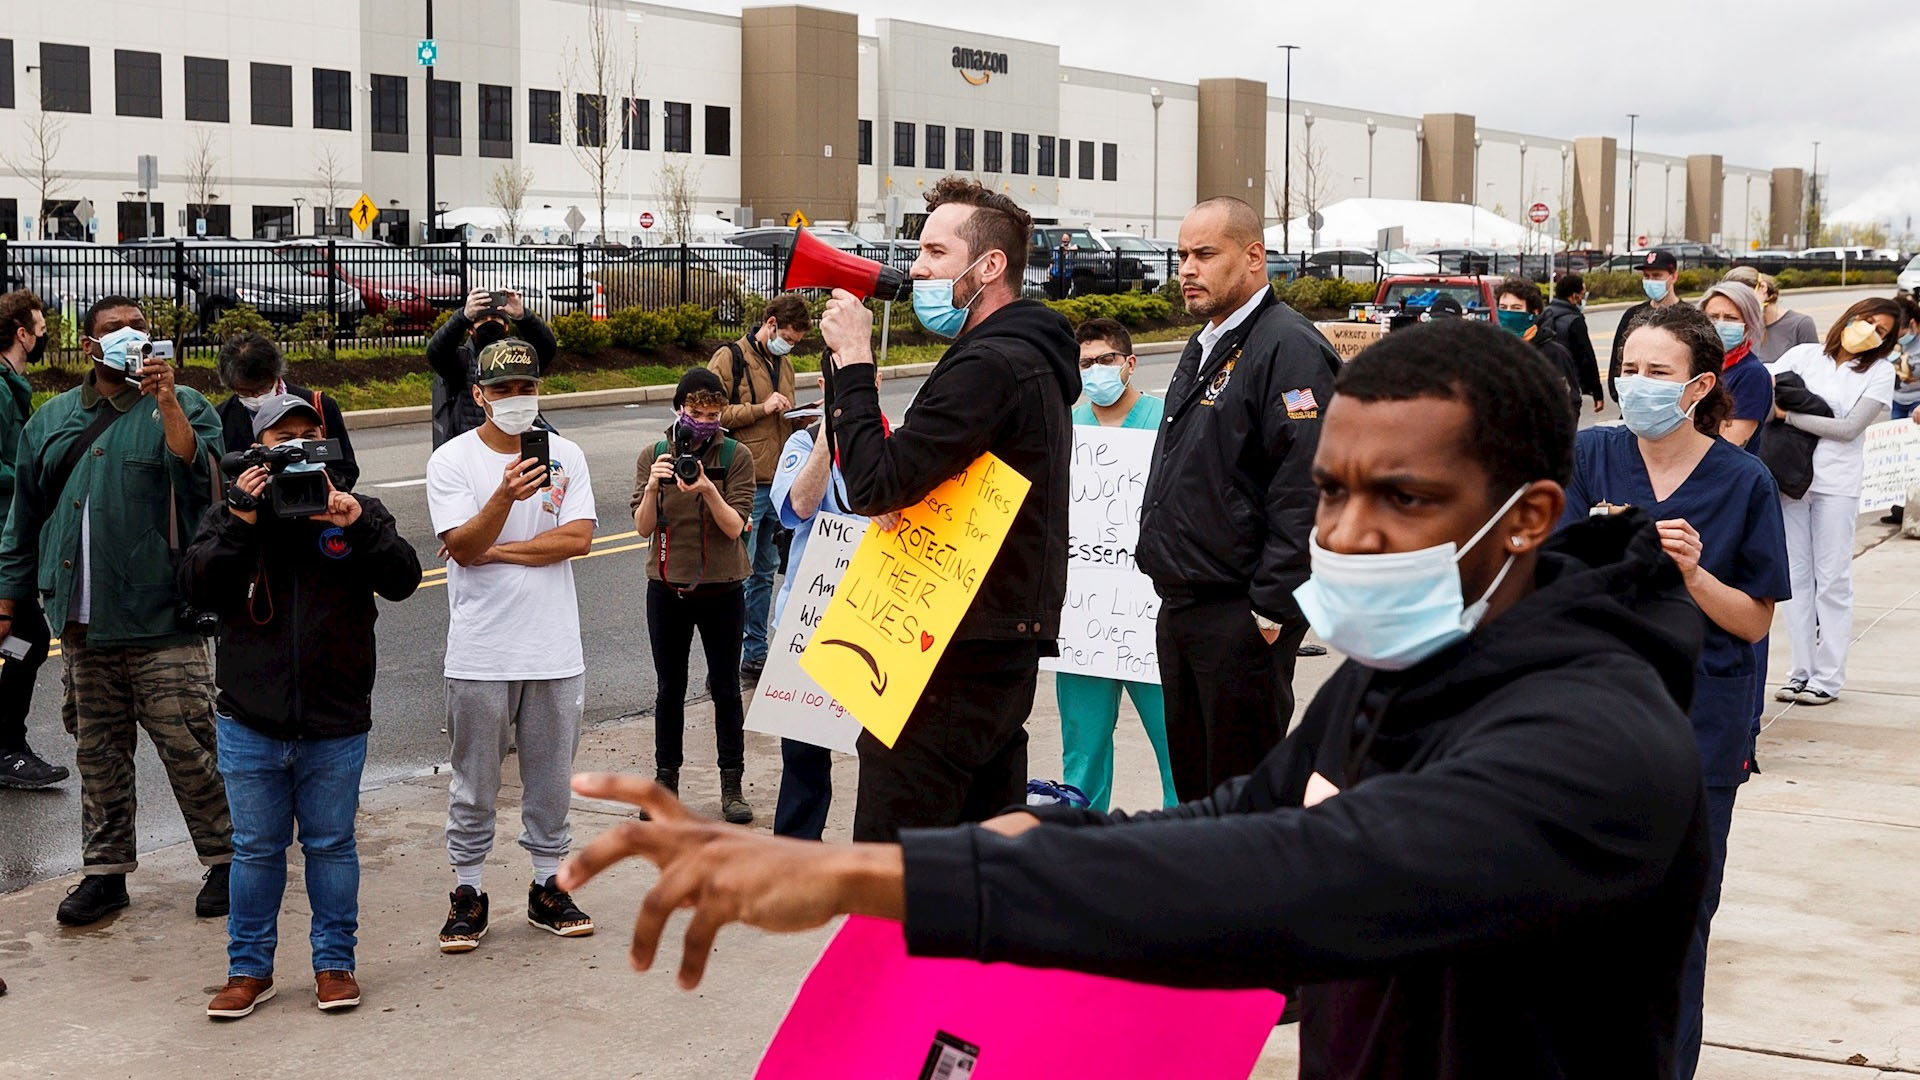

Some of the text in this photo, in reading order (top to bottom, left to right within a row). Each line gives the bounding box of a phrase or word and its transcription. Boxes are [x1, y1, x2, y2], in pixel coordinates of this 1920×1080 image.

[952, 46, 1008, 74] amazon
[490, 349, 531, 370] Knicks
[1074, 430, 1118, 466] he
[950, 461, 1011, 514] on fires
[1071, 466, 1144, 502] Work
[819, 518, 855, 543] NYC
[924, 497, 990, 542] ers for
[1097, 520, 1118, 543] is
[835, 549, 850, 570] in
[876, 518, 976, 593] ROTECTING
[1068, 536, 1136, 570] Essent
[808, 574, 835, 597] Am
[882, 551, 936, 609] THEIR
[846, 577, 919, 644] LIVES
[1062, 587, 1157, 620] ur Live
[1087, 619, 1136, 643] Over
[1116, 646, 1159, 676] Profi
[765, 685, 850, 717] Local 100 Fig
